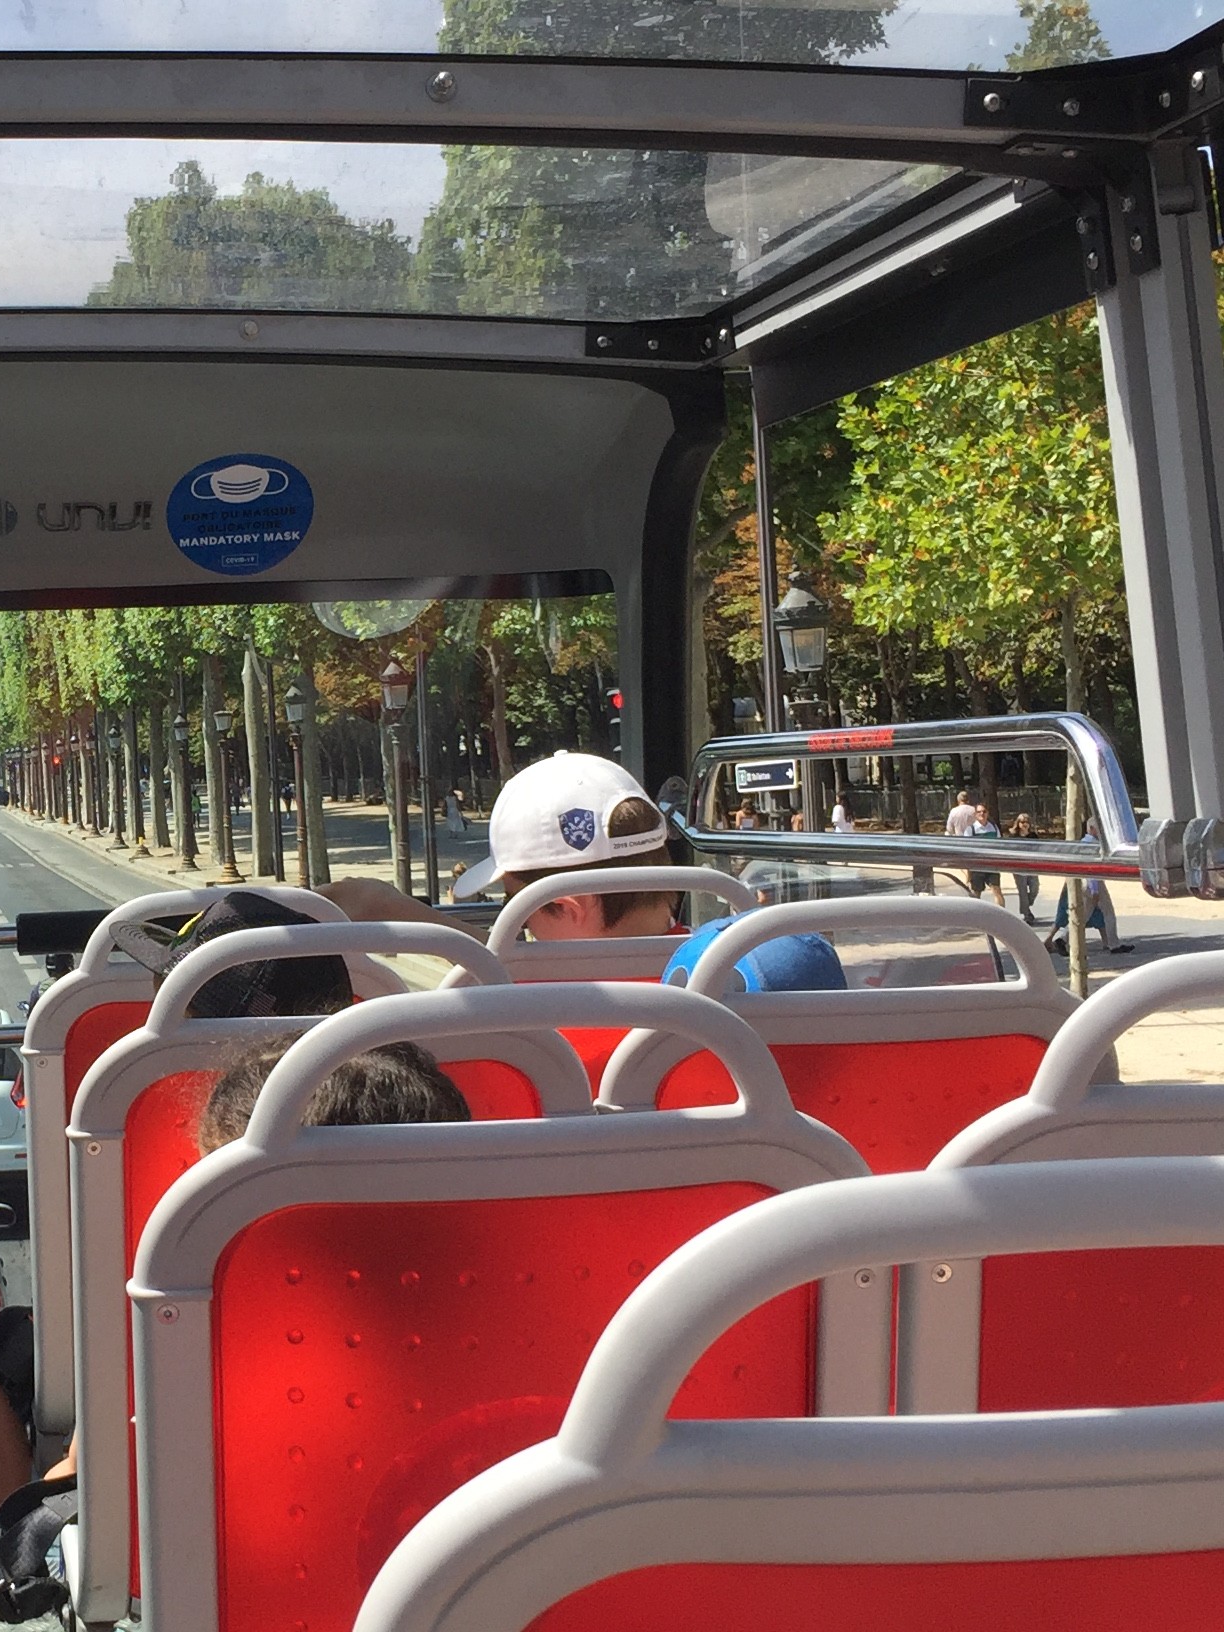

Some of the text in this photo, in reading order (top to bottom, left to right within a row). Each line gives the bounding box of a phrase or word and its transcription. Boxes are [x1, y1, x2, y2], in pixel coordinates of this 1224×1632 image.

[183, 505, 297, 522] PORT DU MASQUE
[179, 531, 300, 548] MANDATORY MASK
